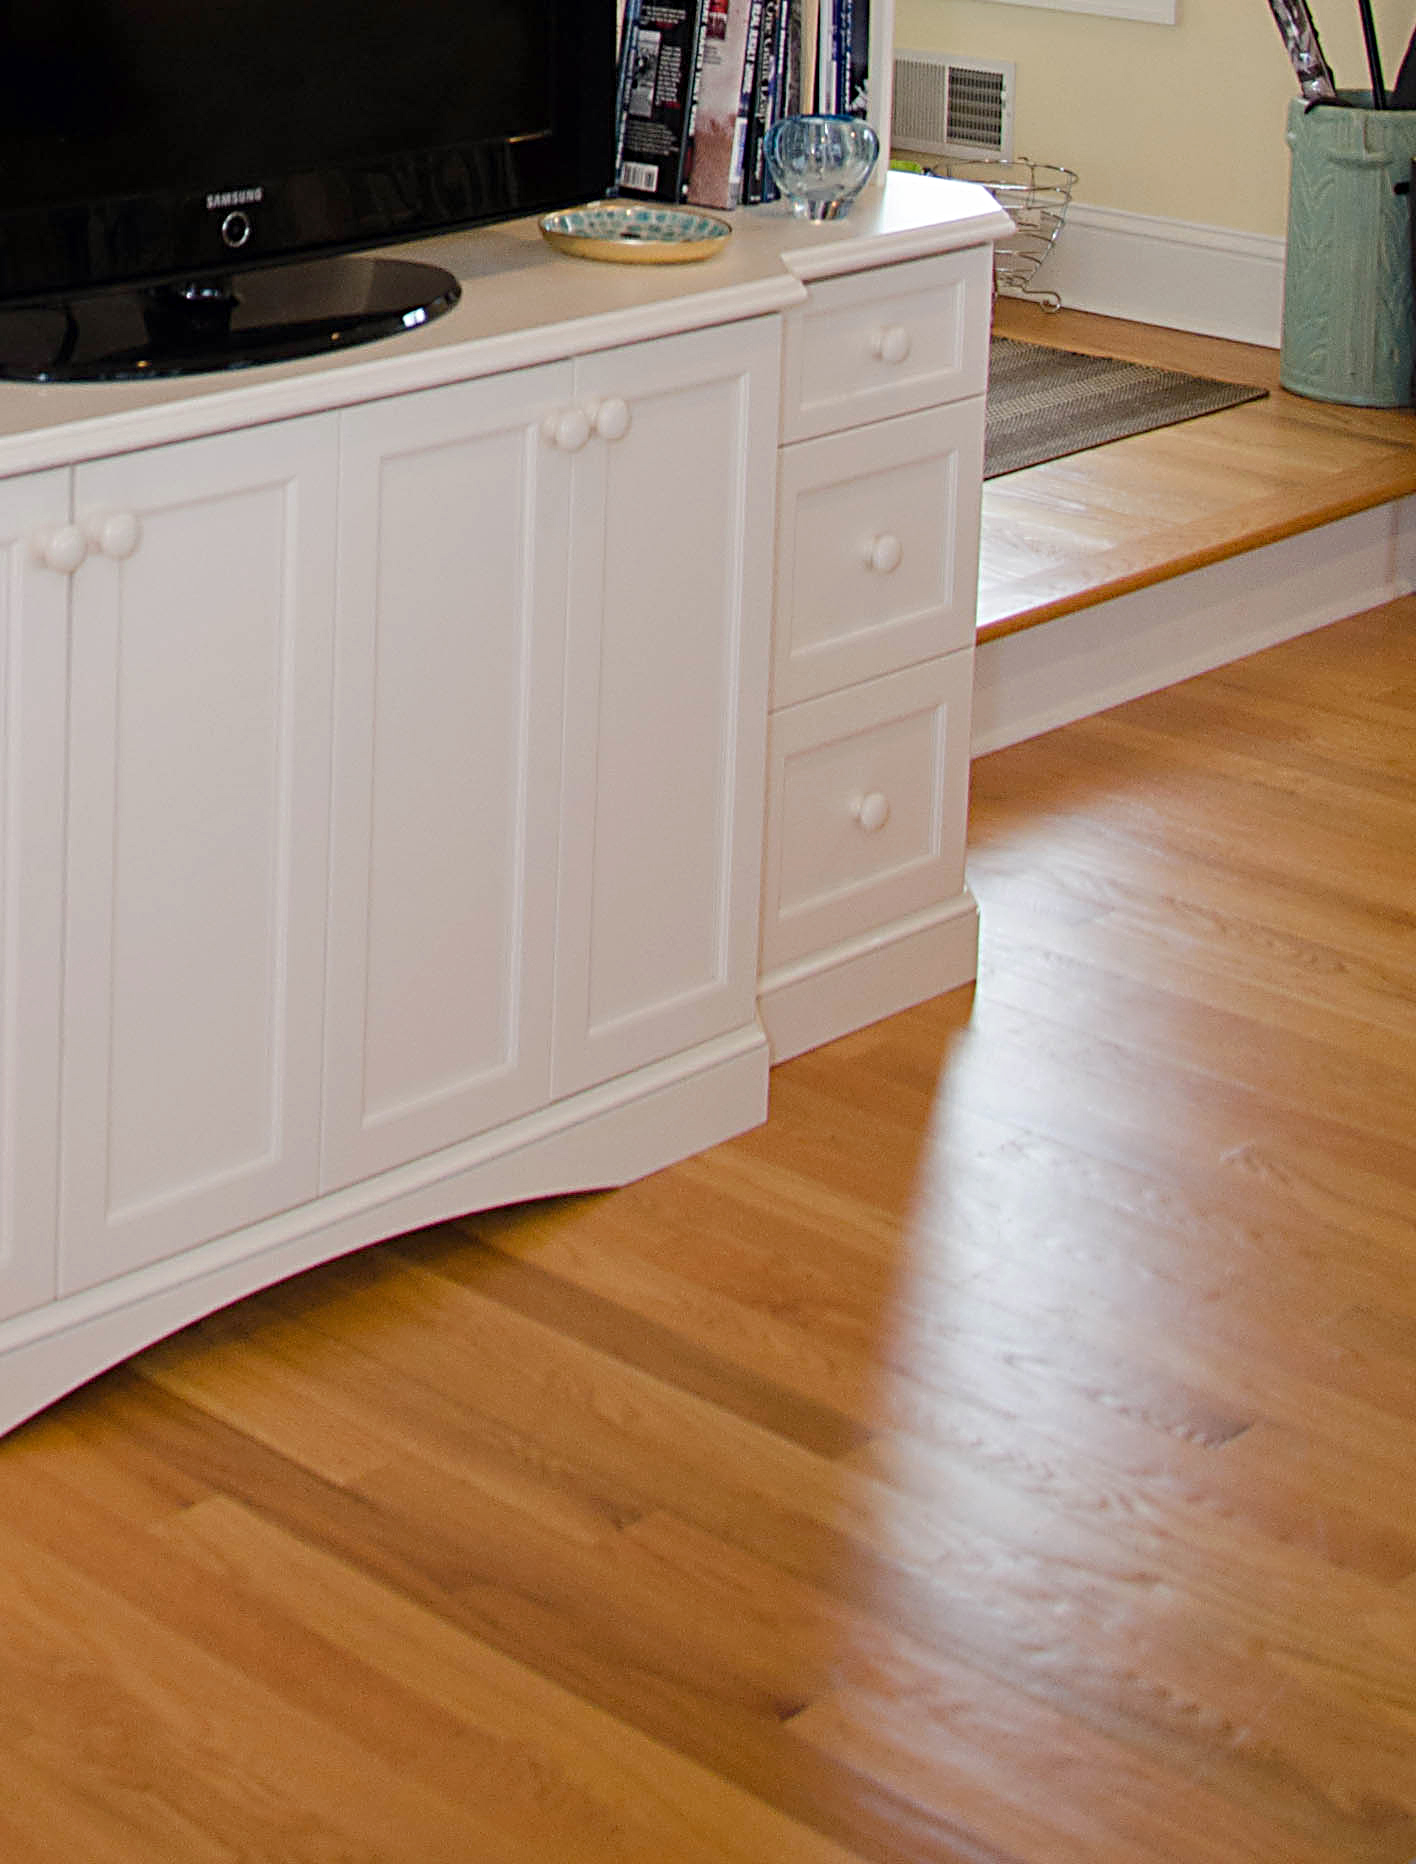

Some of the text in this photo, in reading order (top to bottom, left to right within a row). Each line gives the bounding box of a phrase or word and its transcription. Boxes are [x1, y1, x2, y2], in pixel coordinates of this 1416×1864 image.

[765, 2, 776, 35] One
[755, 85, 770, 123] Leap
[206, 186, 264, 209] SAMSUNG
